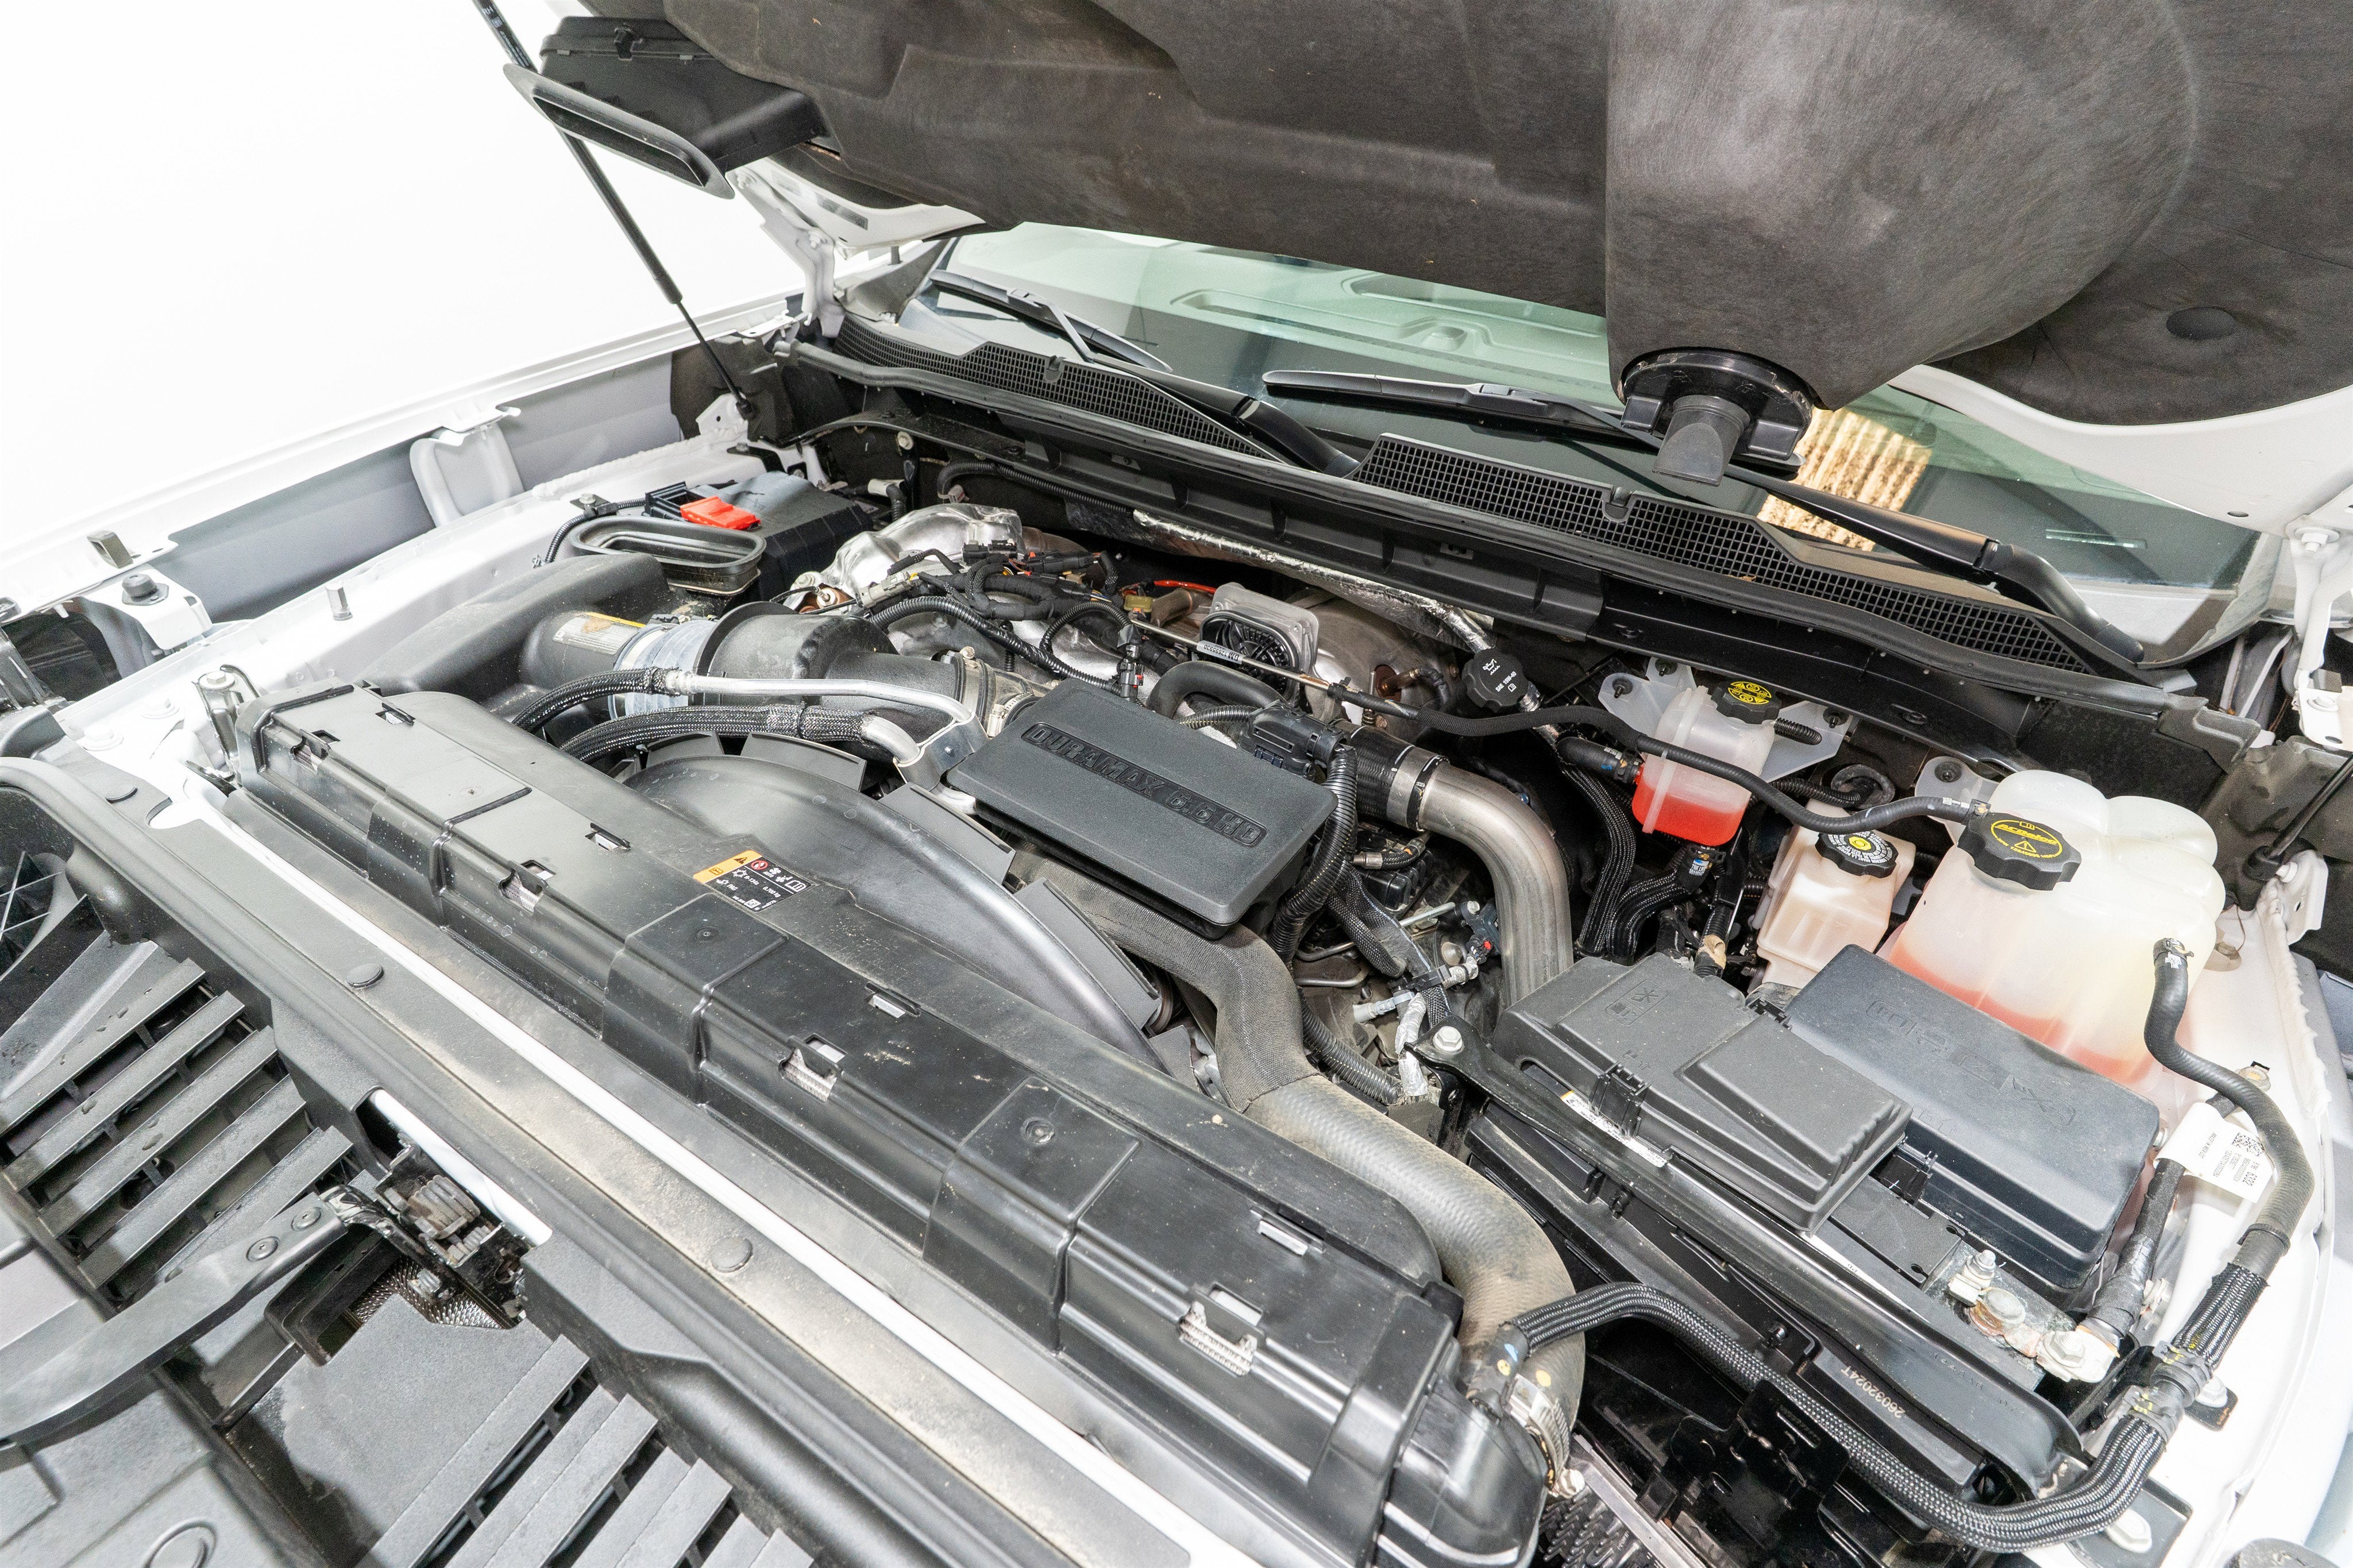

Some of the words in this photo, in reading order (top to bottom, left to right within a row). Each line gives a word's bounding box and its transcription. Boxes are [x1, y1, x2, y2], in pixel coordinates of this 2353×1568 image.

[1228, 652, 1239, 661] GM
[1495, 683, 1505, 692] SAE
[1503, 671, 1517, 685] 15W-40
[1025, 727, 1165, 798] DURAMAX
[1166, 791, 1217, 822] 6.6
[1215, 813, 1263, 845] HD
[1995, 824, 2058, 845] ACDelco
[744, 875, 760, 886] R-134a
[2242, 1172, 2257, 1185] 6332
[1841, 1366, 1905, 1419] 26032024T
